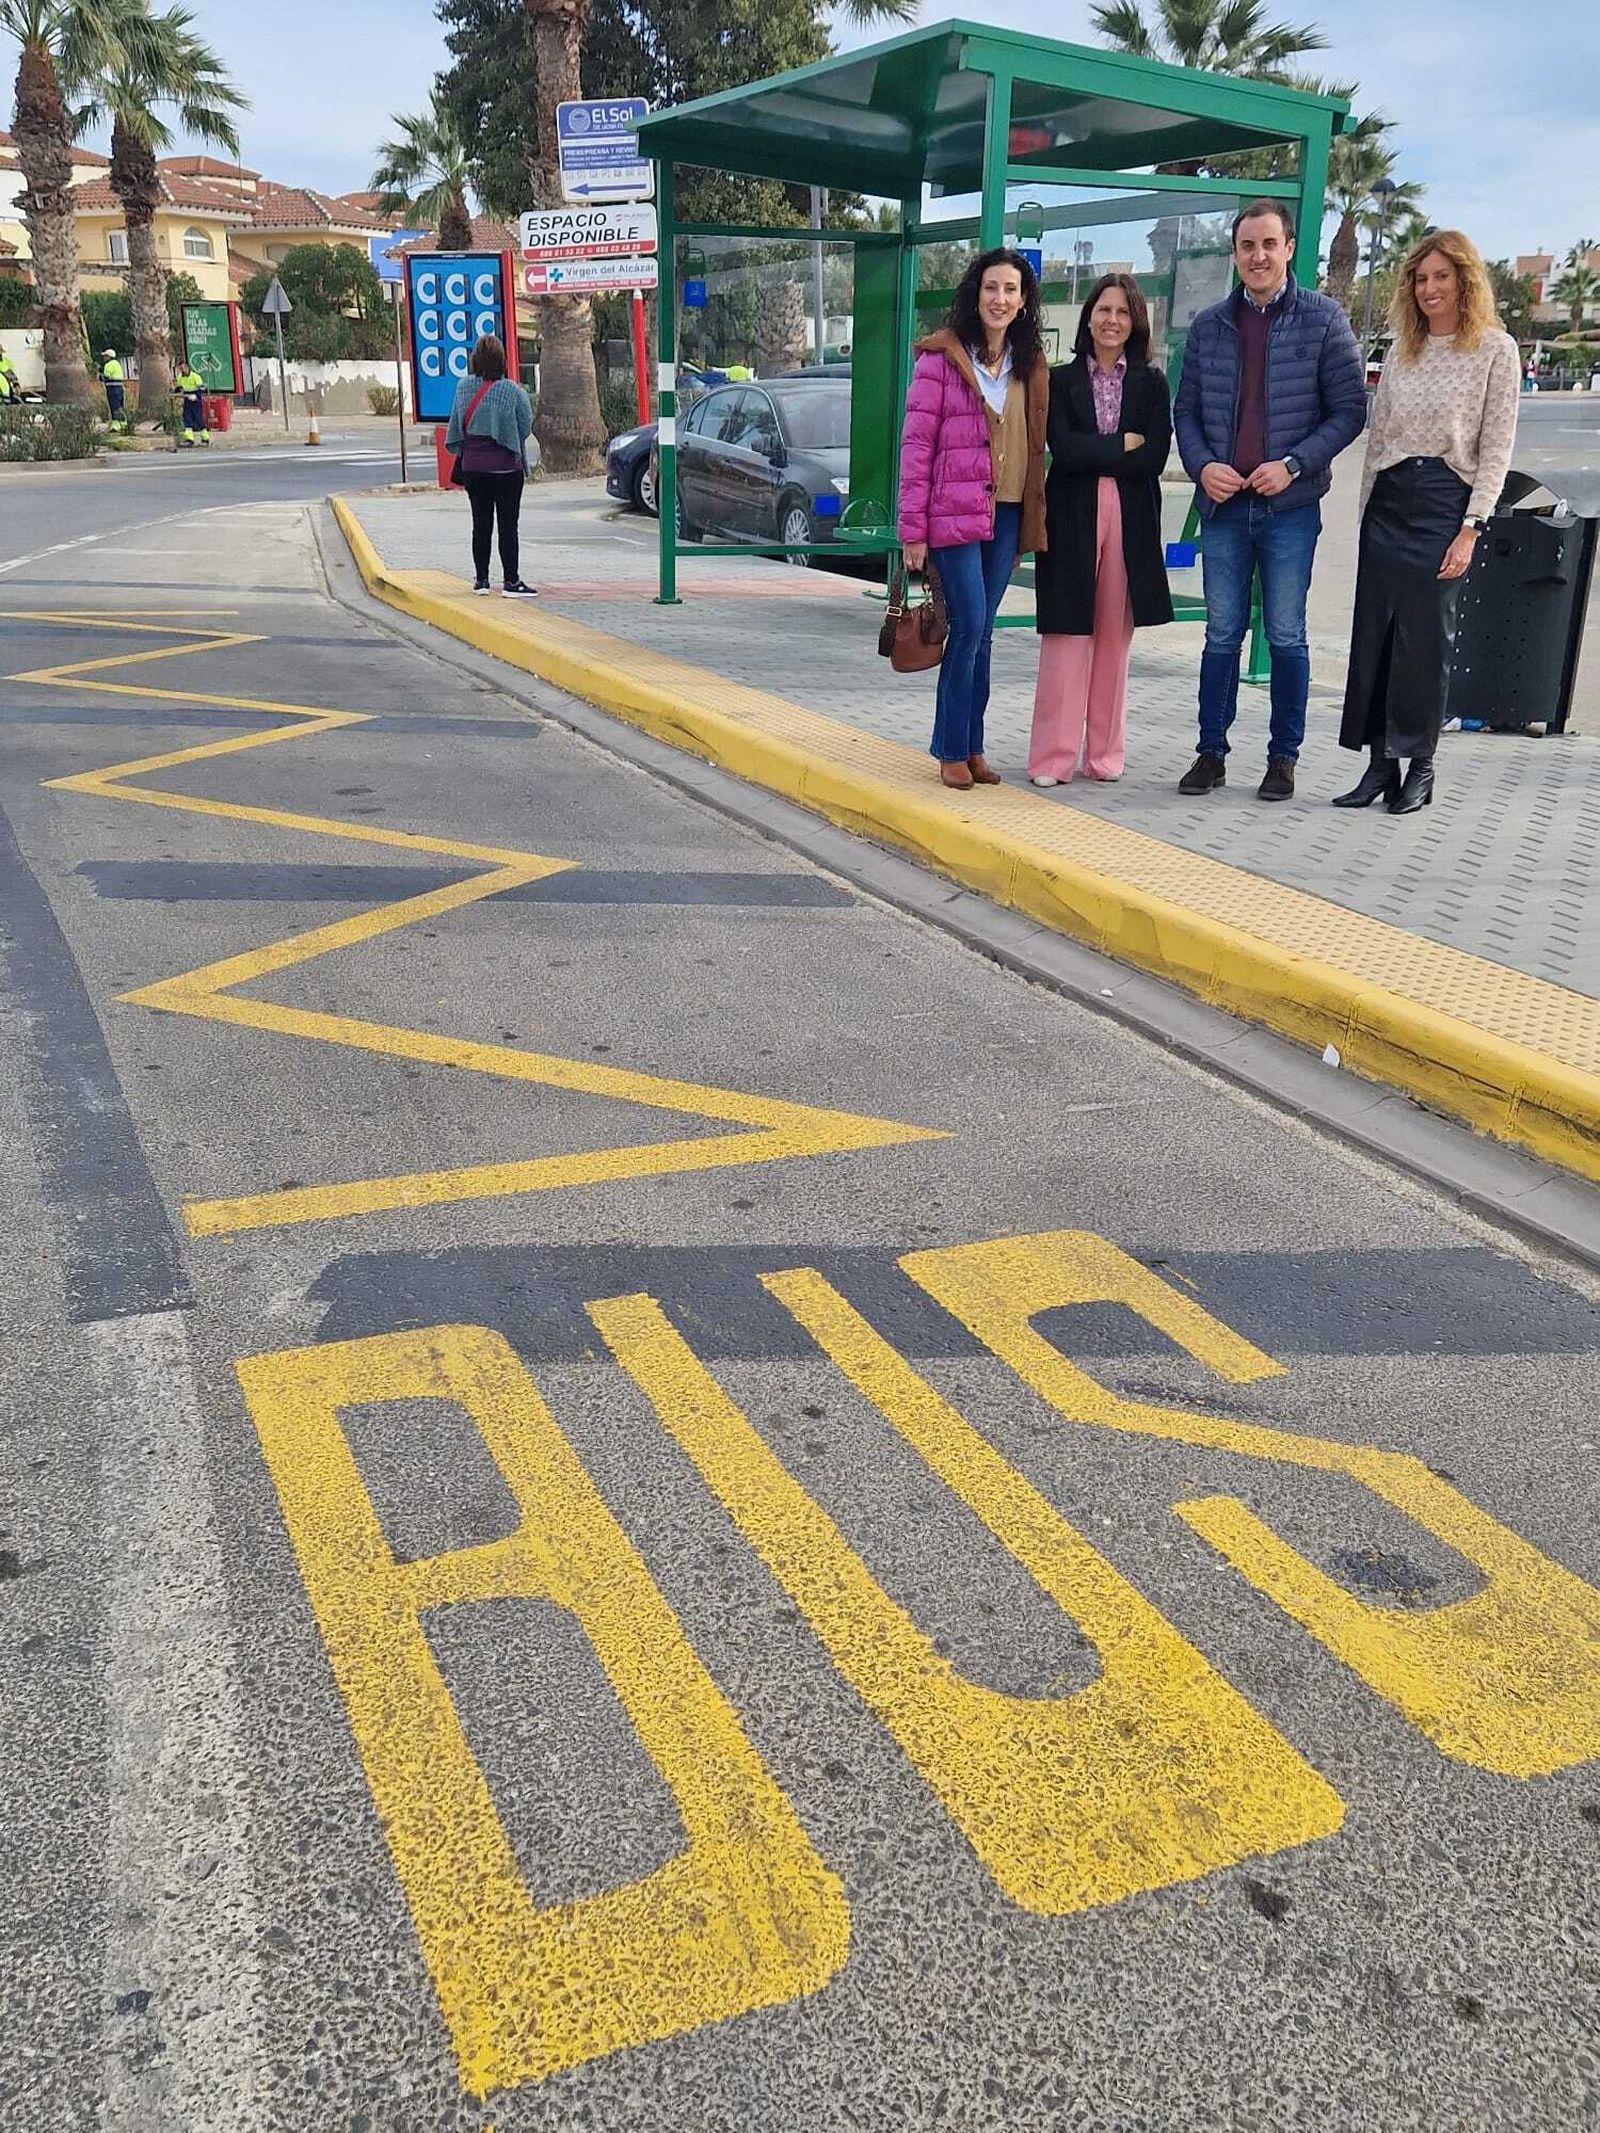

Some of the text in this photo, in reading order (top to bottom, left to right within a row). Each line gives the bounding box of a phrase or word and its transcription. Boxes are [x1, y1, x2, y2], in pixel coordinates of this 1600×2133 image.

[592, 107, 633, 123] El Sol
[527, 213, 607, 231] ESPACIO
[529, 227, 639, 247] DISPONIBLE
[565, 262, 655, 278] Virgen del Alcázar
[186, 310, 199, 319] TUS
[186, 318, 207, 326] PILAS
[187, 327, 217, 336] USADAS
[235, 1229, 1600, 2100] BUS
